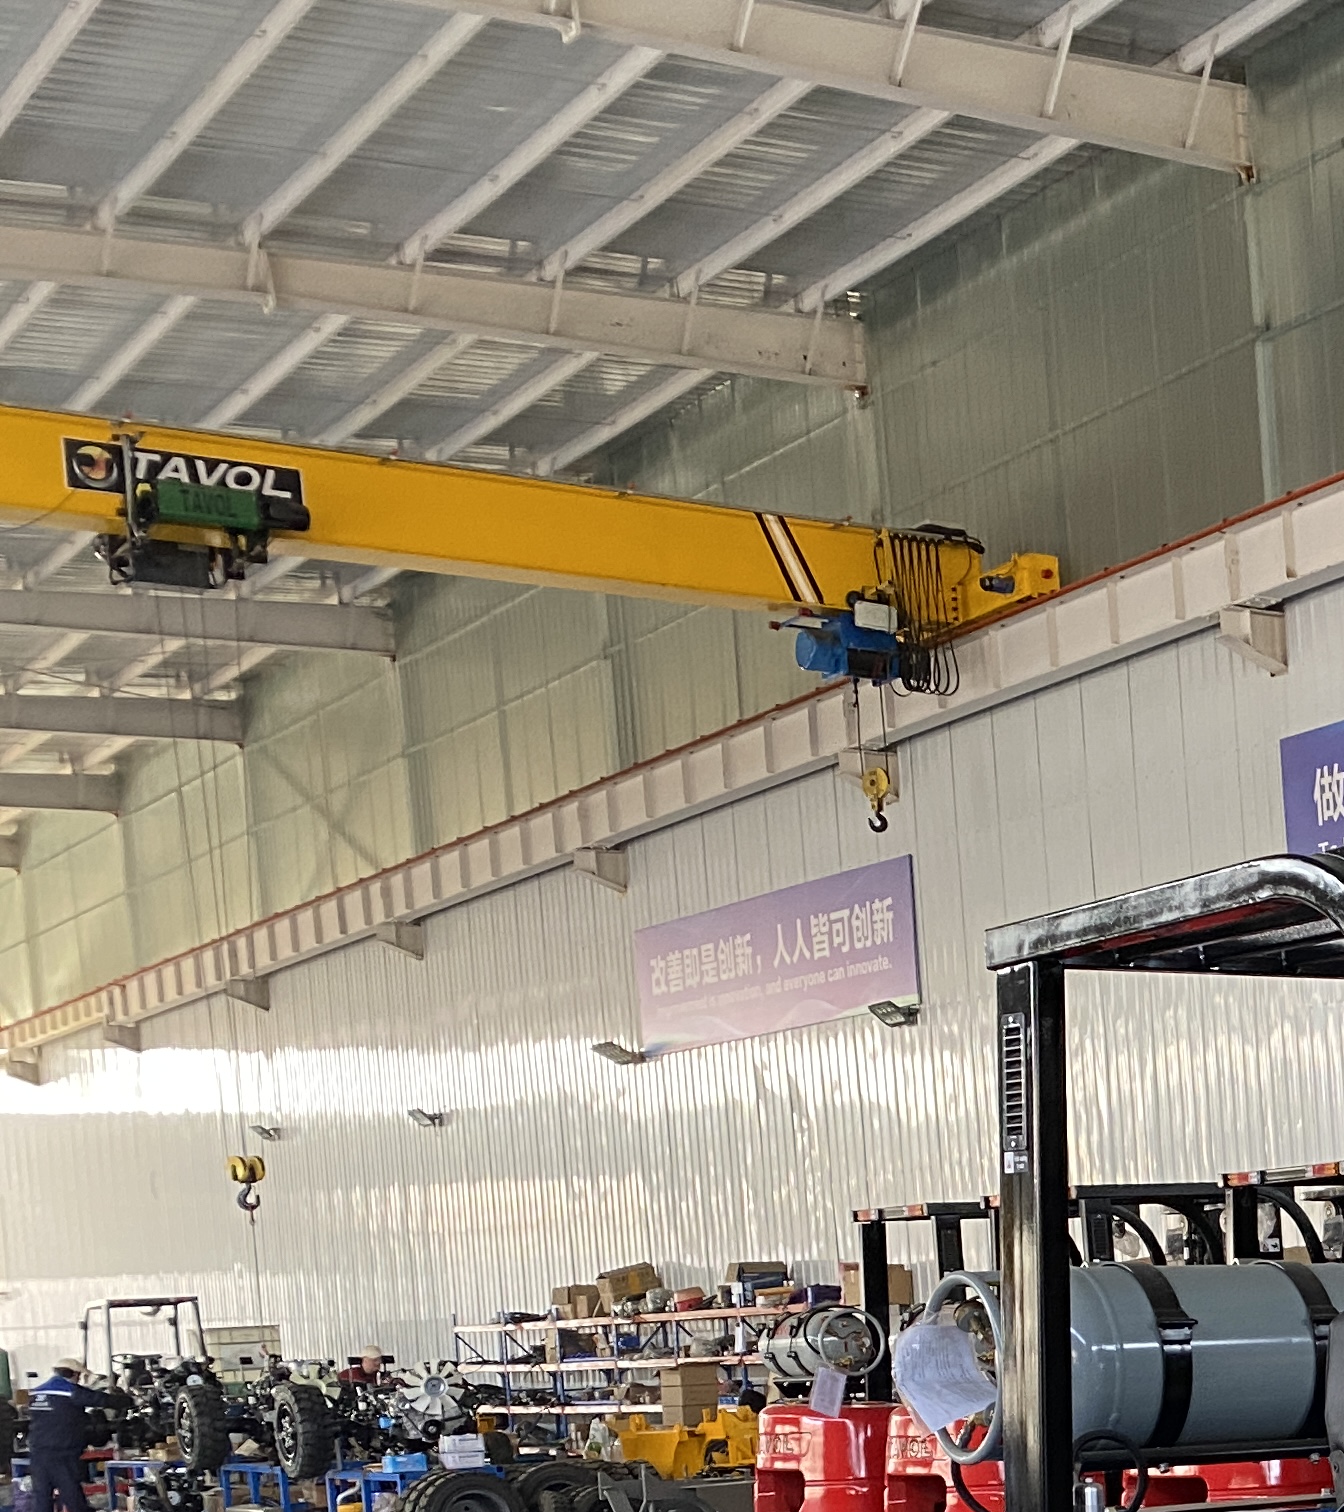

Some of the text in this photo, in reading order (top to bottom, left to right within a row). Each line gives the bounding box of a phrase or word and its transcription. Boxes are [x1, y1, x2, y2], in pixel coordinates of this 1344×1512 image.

[133, 451, 292, 499] TAVOL
[783, 969, 826, 992] everyone
[827, 966, 845, 983] can
[846, 954, 893, 978] innovate.
